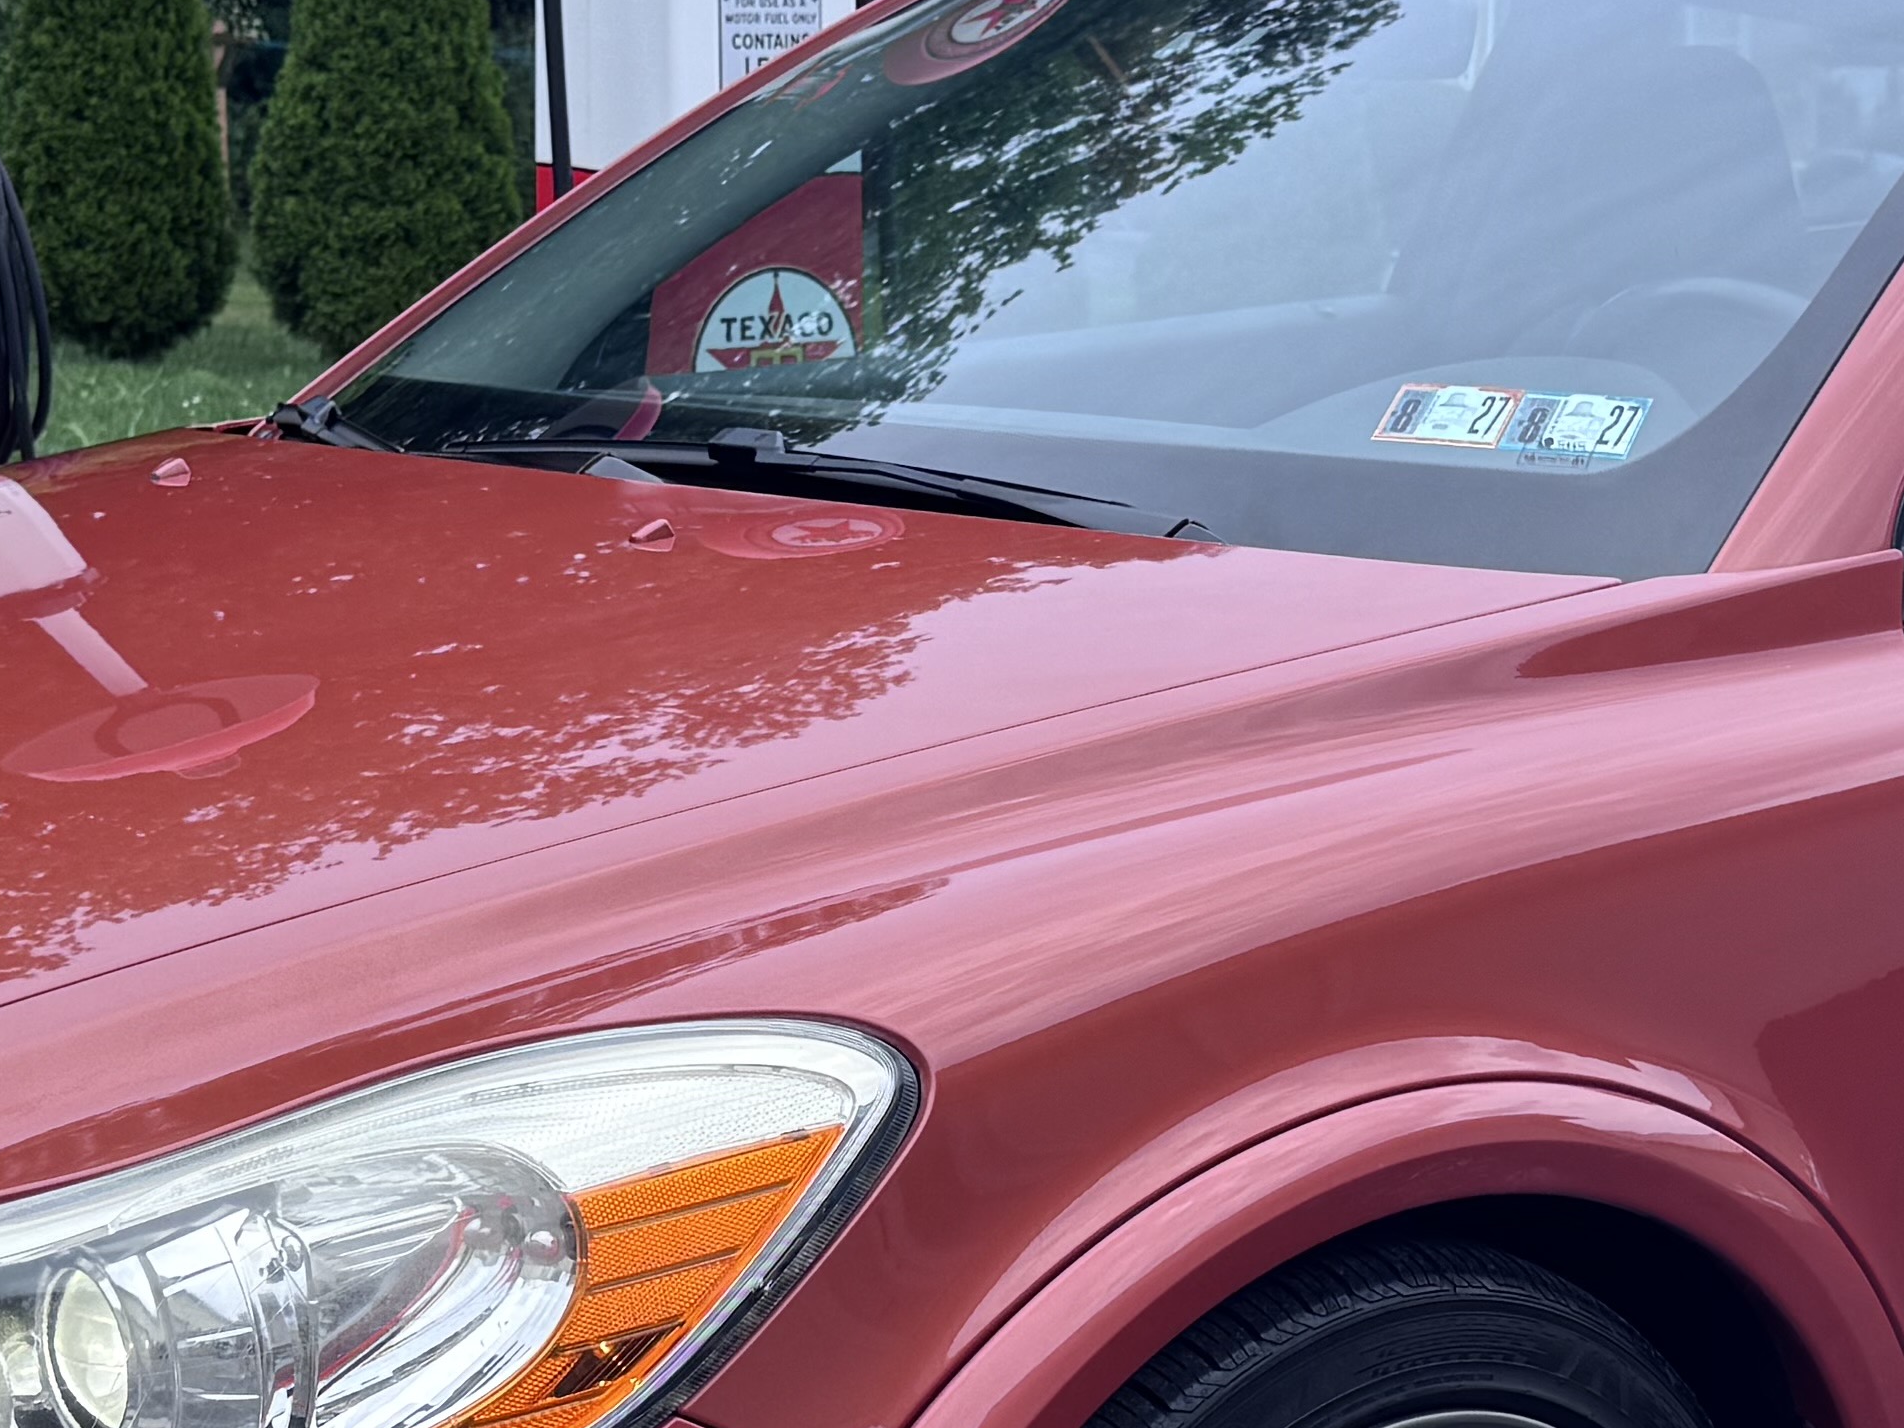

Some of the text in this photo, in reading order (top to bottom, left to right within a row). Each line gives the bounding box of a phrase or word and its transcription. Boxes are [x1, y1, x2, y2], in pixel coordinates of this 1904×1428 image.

[725, 13, 817, 25] MOTOR FUEL ONLY
[1392, 396, 1511, 439] 8 27
[1518, 404, 1641, 449] 8 27
